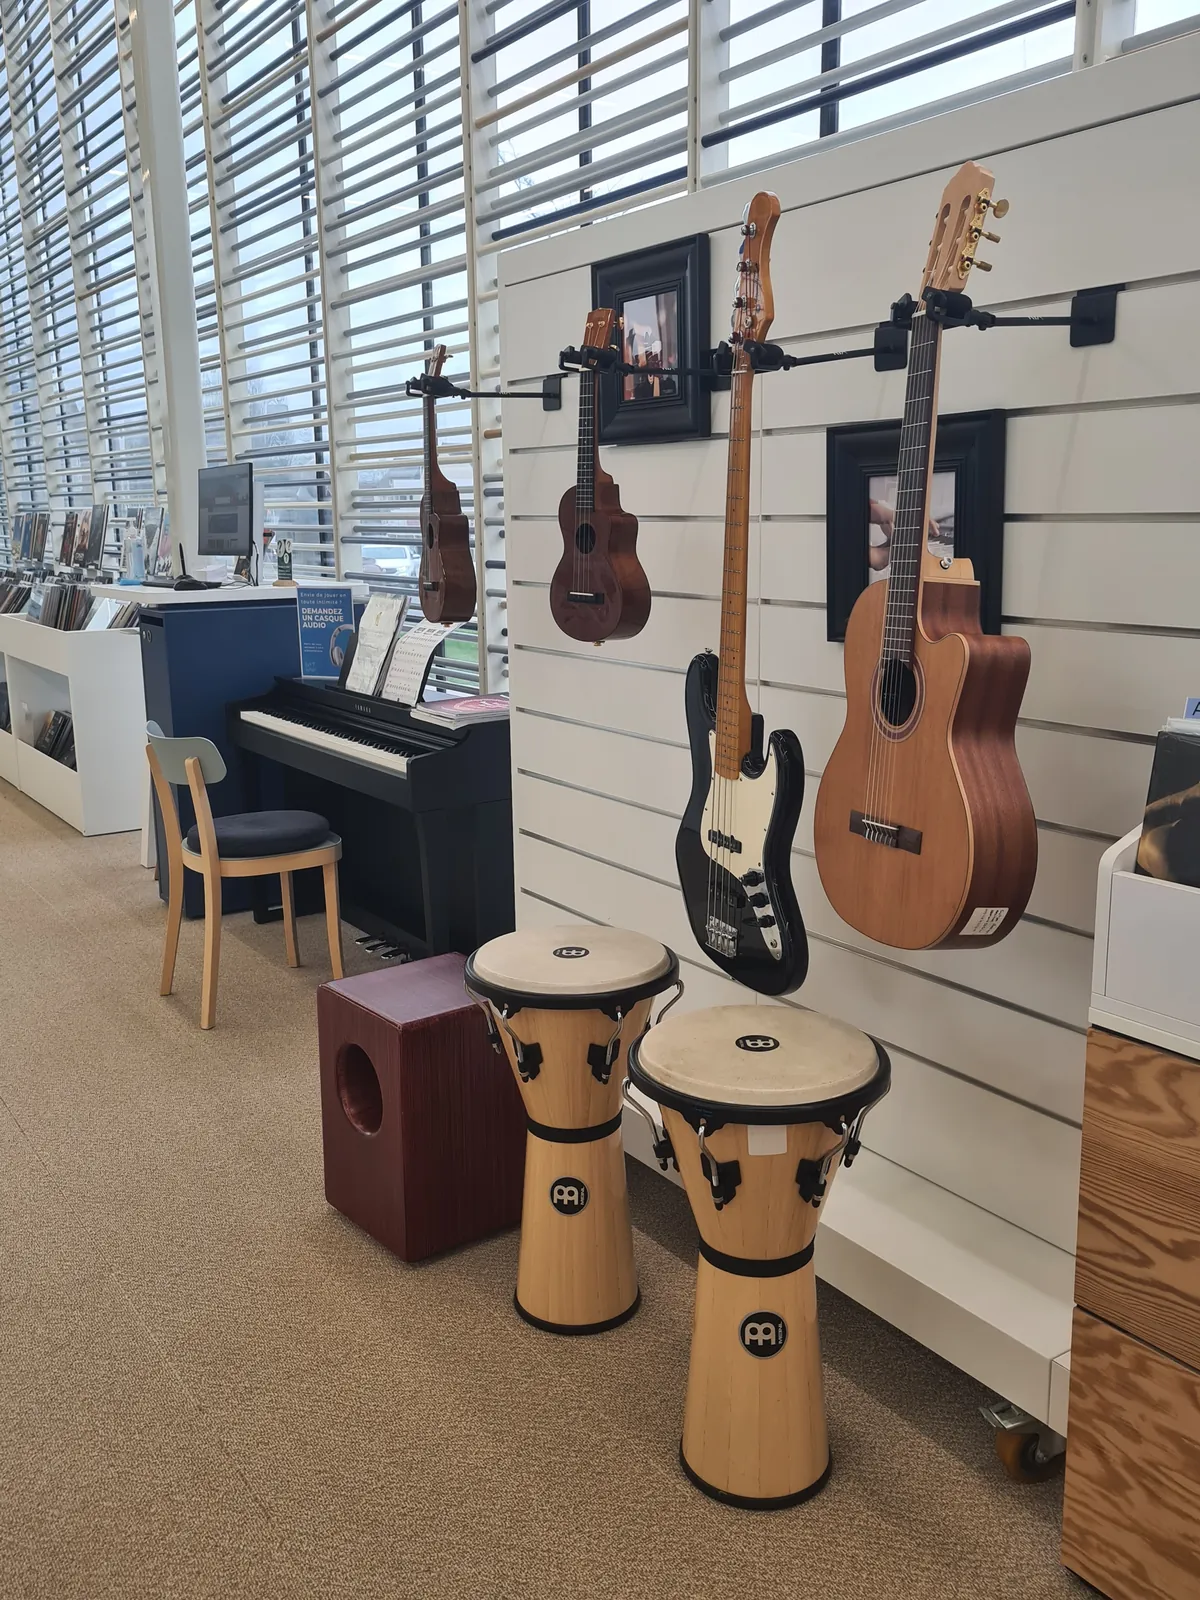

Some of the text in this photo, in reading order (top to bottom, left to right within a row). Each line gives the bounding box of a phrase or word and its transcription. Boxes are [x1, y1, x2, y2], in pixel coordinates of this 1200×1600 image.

[301, 607, 343, 615] DEMANDEZ
[302, 614, 344, 623] UN CASQUE
